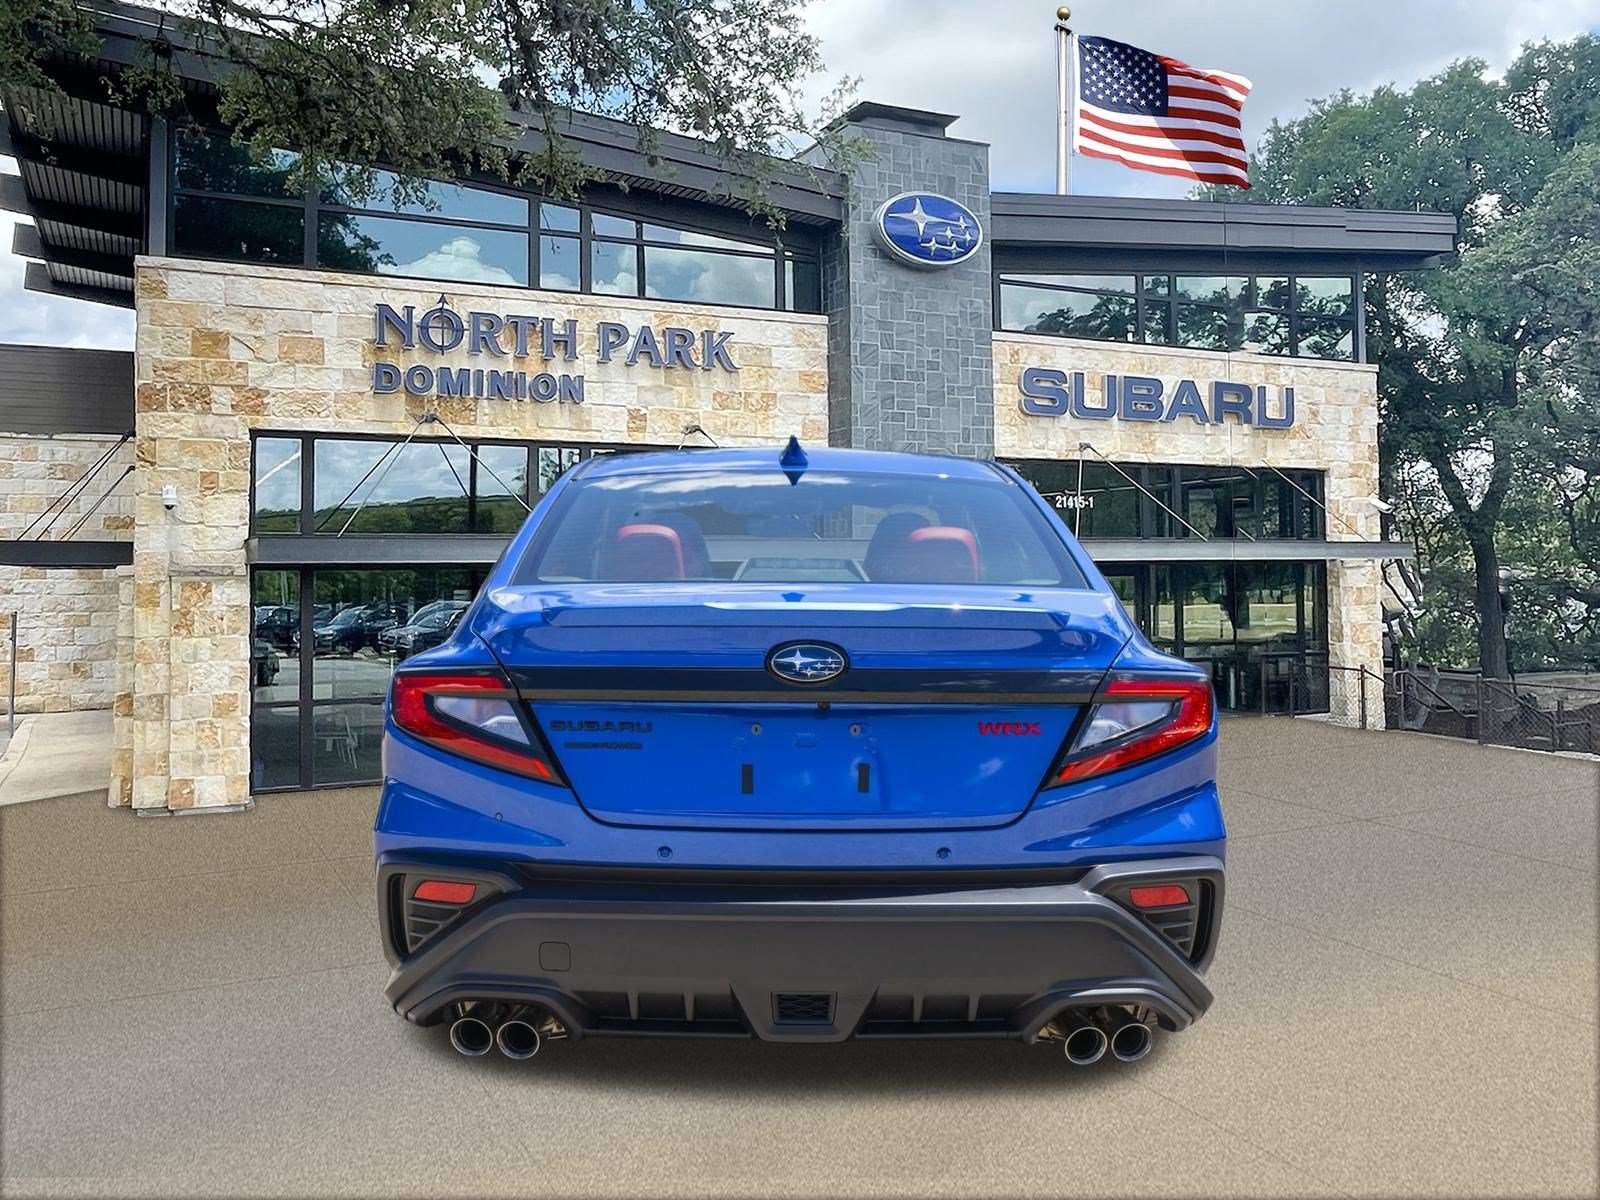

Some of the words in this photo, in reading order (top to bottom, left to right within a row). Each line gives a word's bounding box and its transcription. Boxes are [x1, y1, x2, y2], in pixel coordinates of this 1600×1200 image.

[374, 295, 579, 361] NORTH
[597, 321, 742, 373] PARK
[373, 363, 585, 404] DOMINION
[1019, 367, 1294, 429] SUBARU
[550, 720, 653, 732] SUBARU
[978, 721, 1042, 736] WRX
